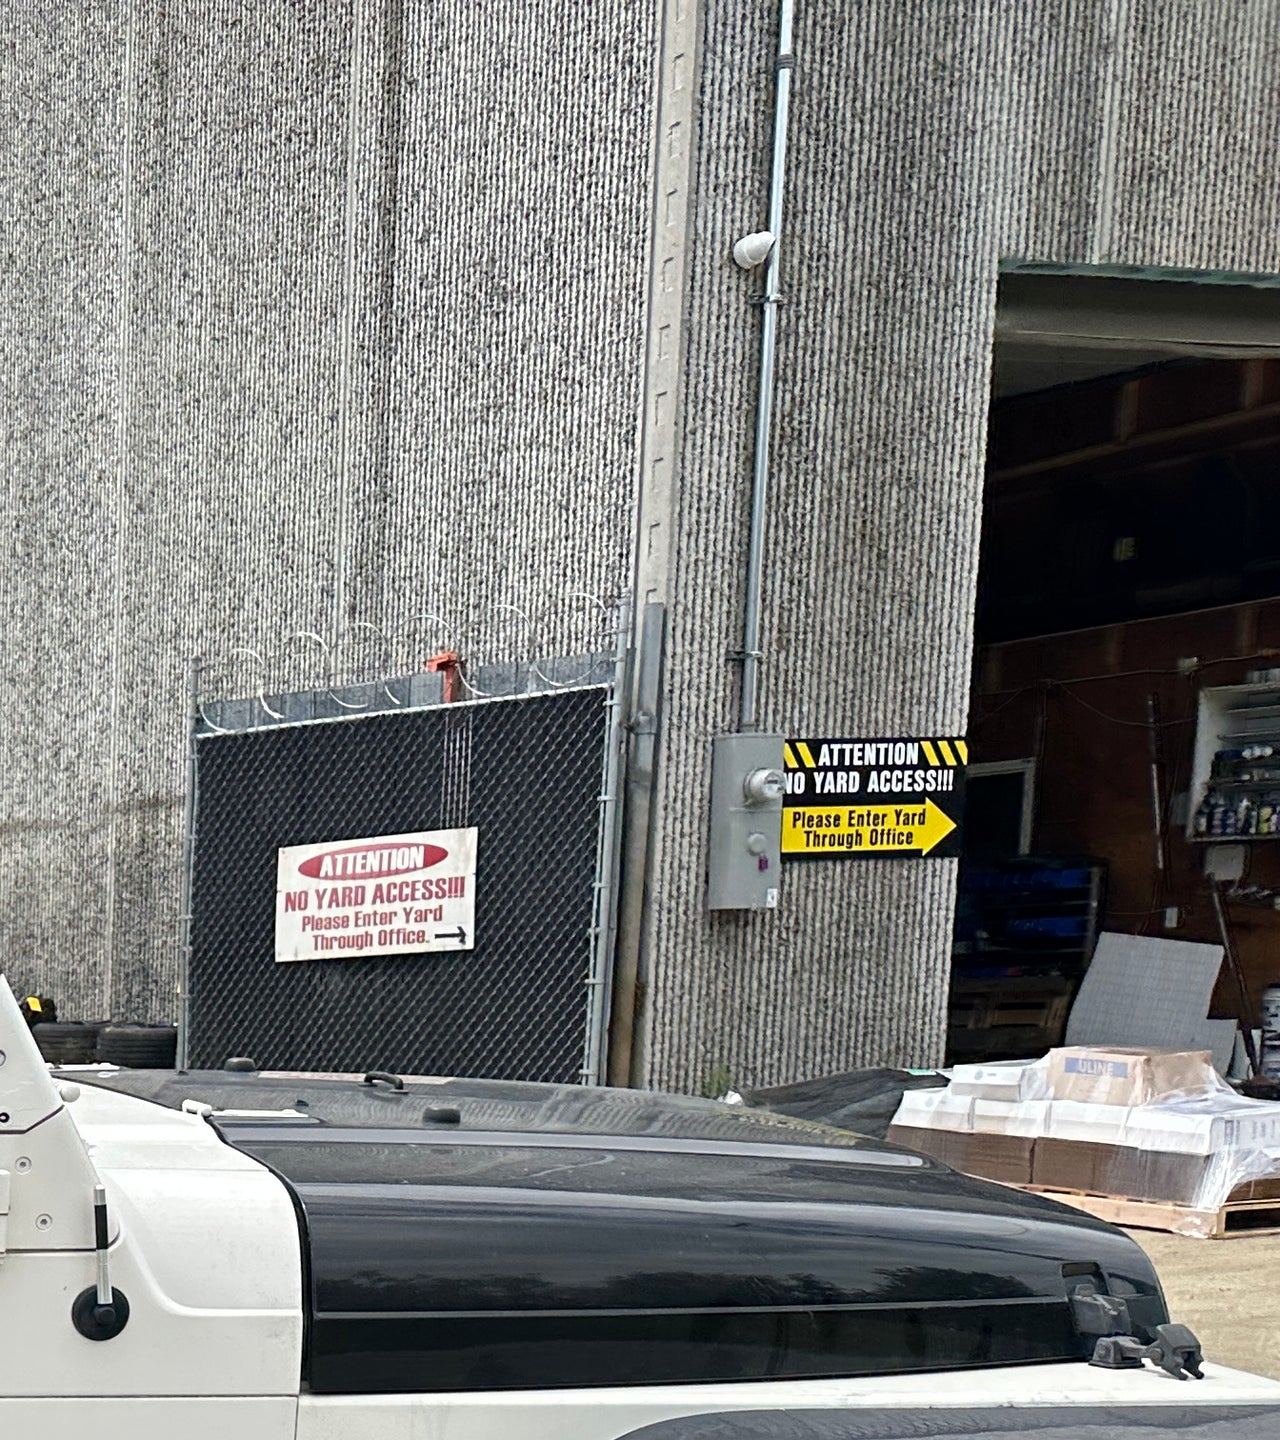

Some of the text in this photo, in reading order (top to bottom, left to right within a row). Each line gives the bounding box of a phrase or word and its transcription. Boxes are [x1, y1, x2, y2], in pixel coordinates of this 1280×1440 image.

[818, 743, 919, 766] ATTENTION
[784, 769, 954, 794] NO YARD ACCESS!!!
[792, 808, 926, 828] Please Enter Yard
[804, 828, 913, 849] Through Office
[319, 845, 425, 878] ATTENTION
[285, 876, 466, 912] NO YARD ACCESS!!!
[302, 905, 443, 932] Please Enter Yard
[312, 931, 373, 951] Through
[1079, 1060, 1115, 1077] ULINE
